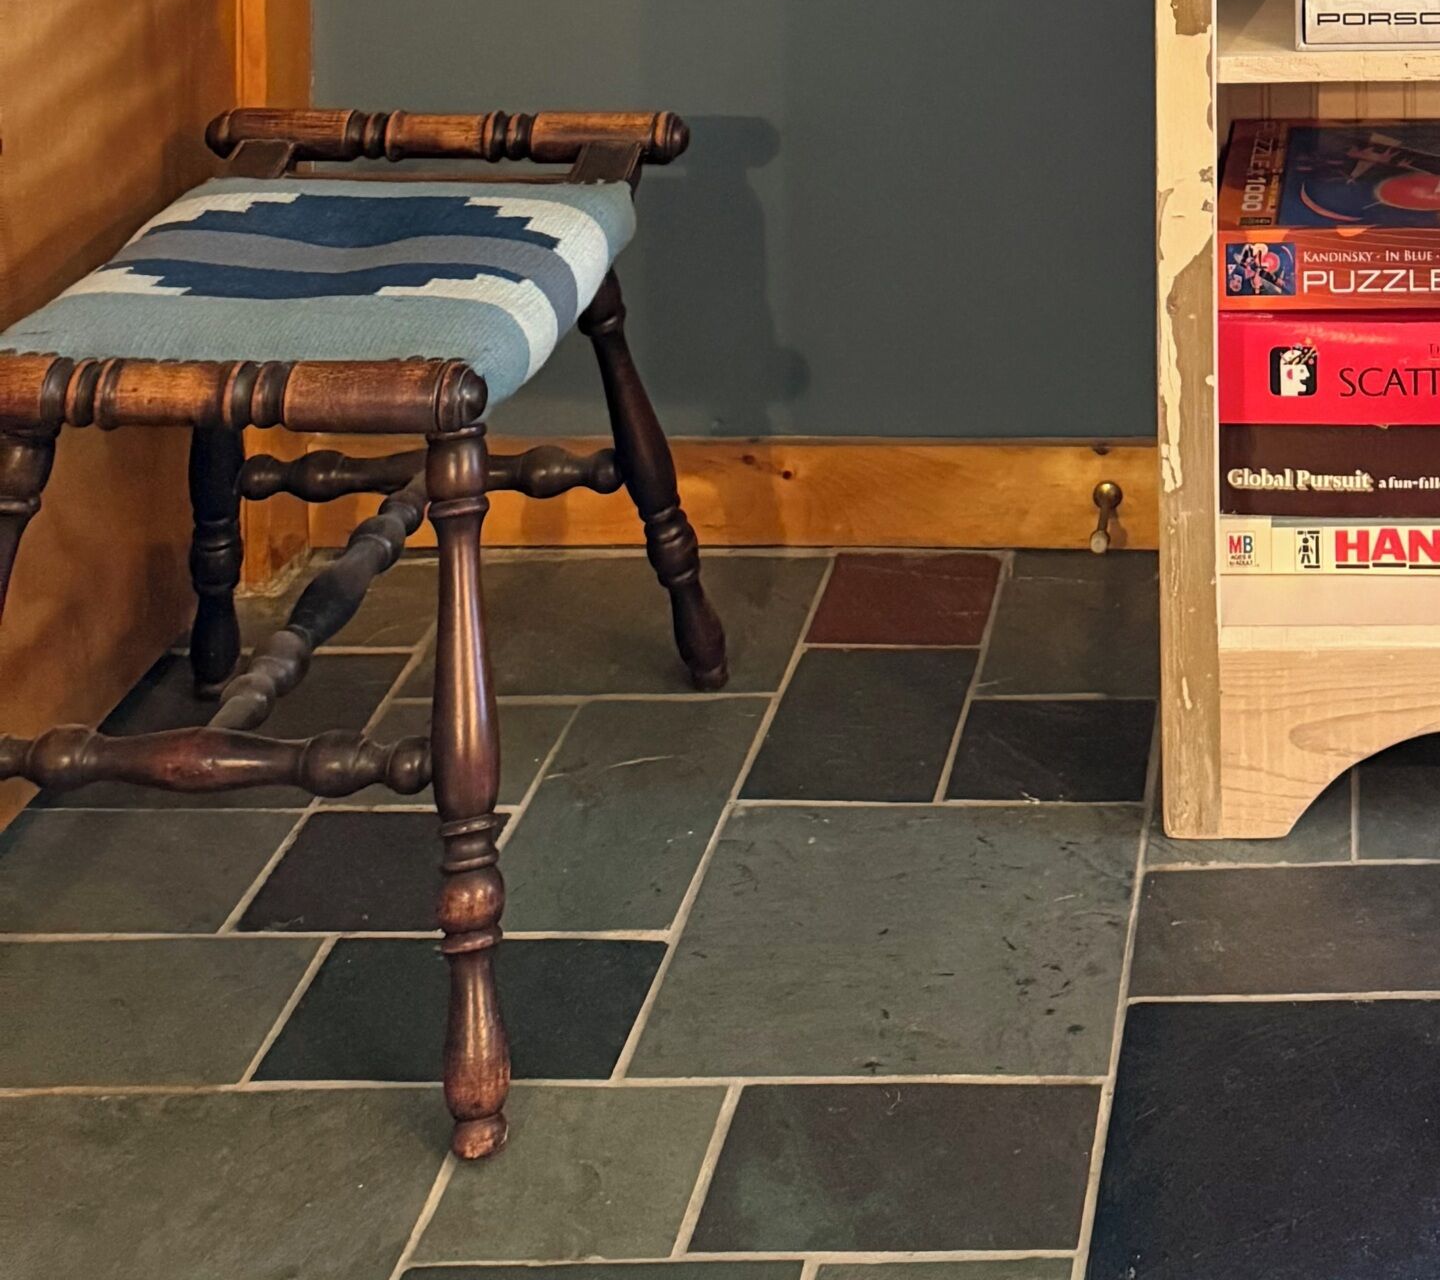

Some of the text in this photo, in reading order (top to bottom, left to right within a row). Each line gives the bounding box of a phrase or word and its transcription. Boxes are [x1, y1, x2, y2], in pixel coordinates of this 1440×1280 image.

[1303, 251, 1373, 263] KANDINSKY
[1385, 250, 1400, 261] IN
[1404, 250, 1433, 262] BLUE
[1229, 535, 1253, 554] MB
